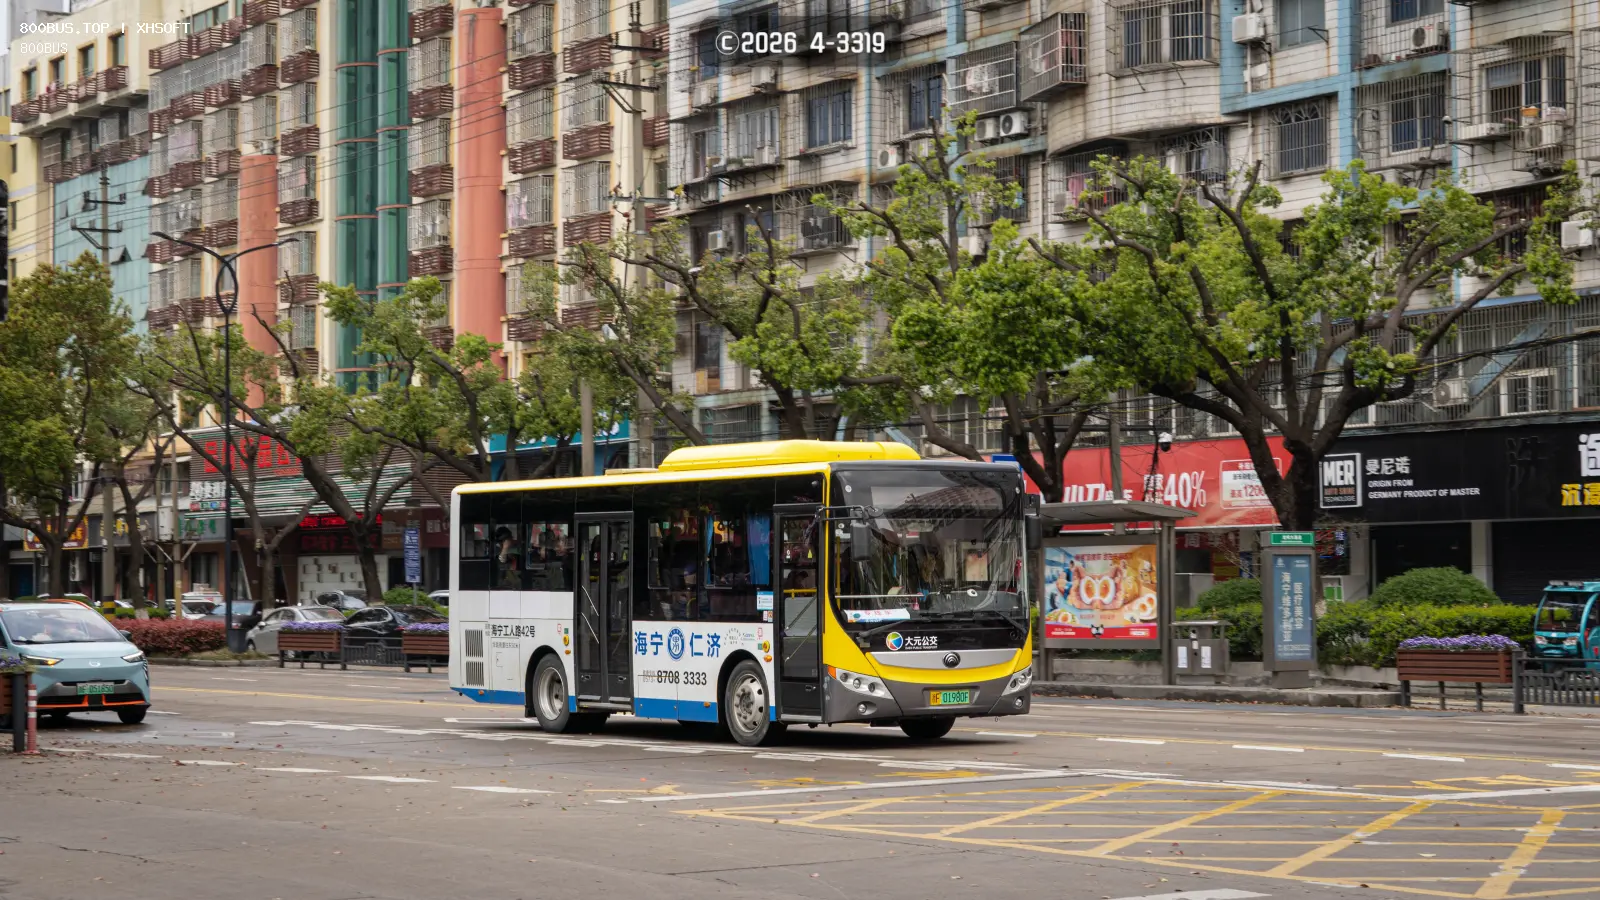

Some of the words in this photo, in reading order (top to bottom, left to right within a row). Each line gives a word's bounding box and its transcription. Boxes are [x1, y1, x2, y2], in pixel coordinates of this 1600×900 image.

[1323, 460, 1355, 486] MER
[1365, 456, 1410, 475] 曼尼诺
[1164, 470, 1207, 508] 40%
[1368, 480, 1392, 488] ORIGIN
[1392, 479, 1414, 487] FROM
[1368, 491, 1402, 499] GERMANY
[1403, 489, 1437, 498] PRODUCT
[1438, 489, 1449, 497] OF
[1449, 487, 1480, 496] MASTER
[490, 623, 536, 638] 海宁工人路42号
[634, 631, 664, 656] 海宁
[689, 632, 721, 658] 仁济
[904, 635, 938, 646] 大元公交
[657, 670, 680, 684] 8708
[683, 671, 708, 686] 3333
